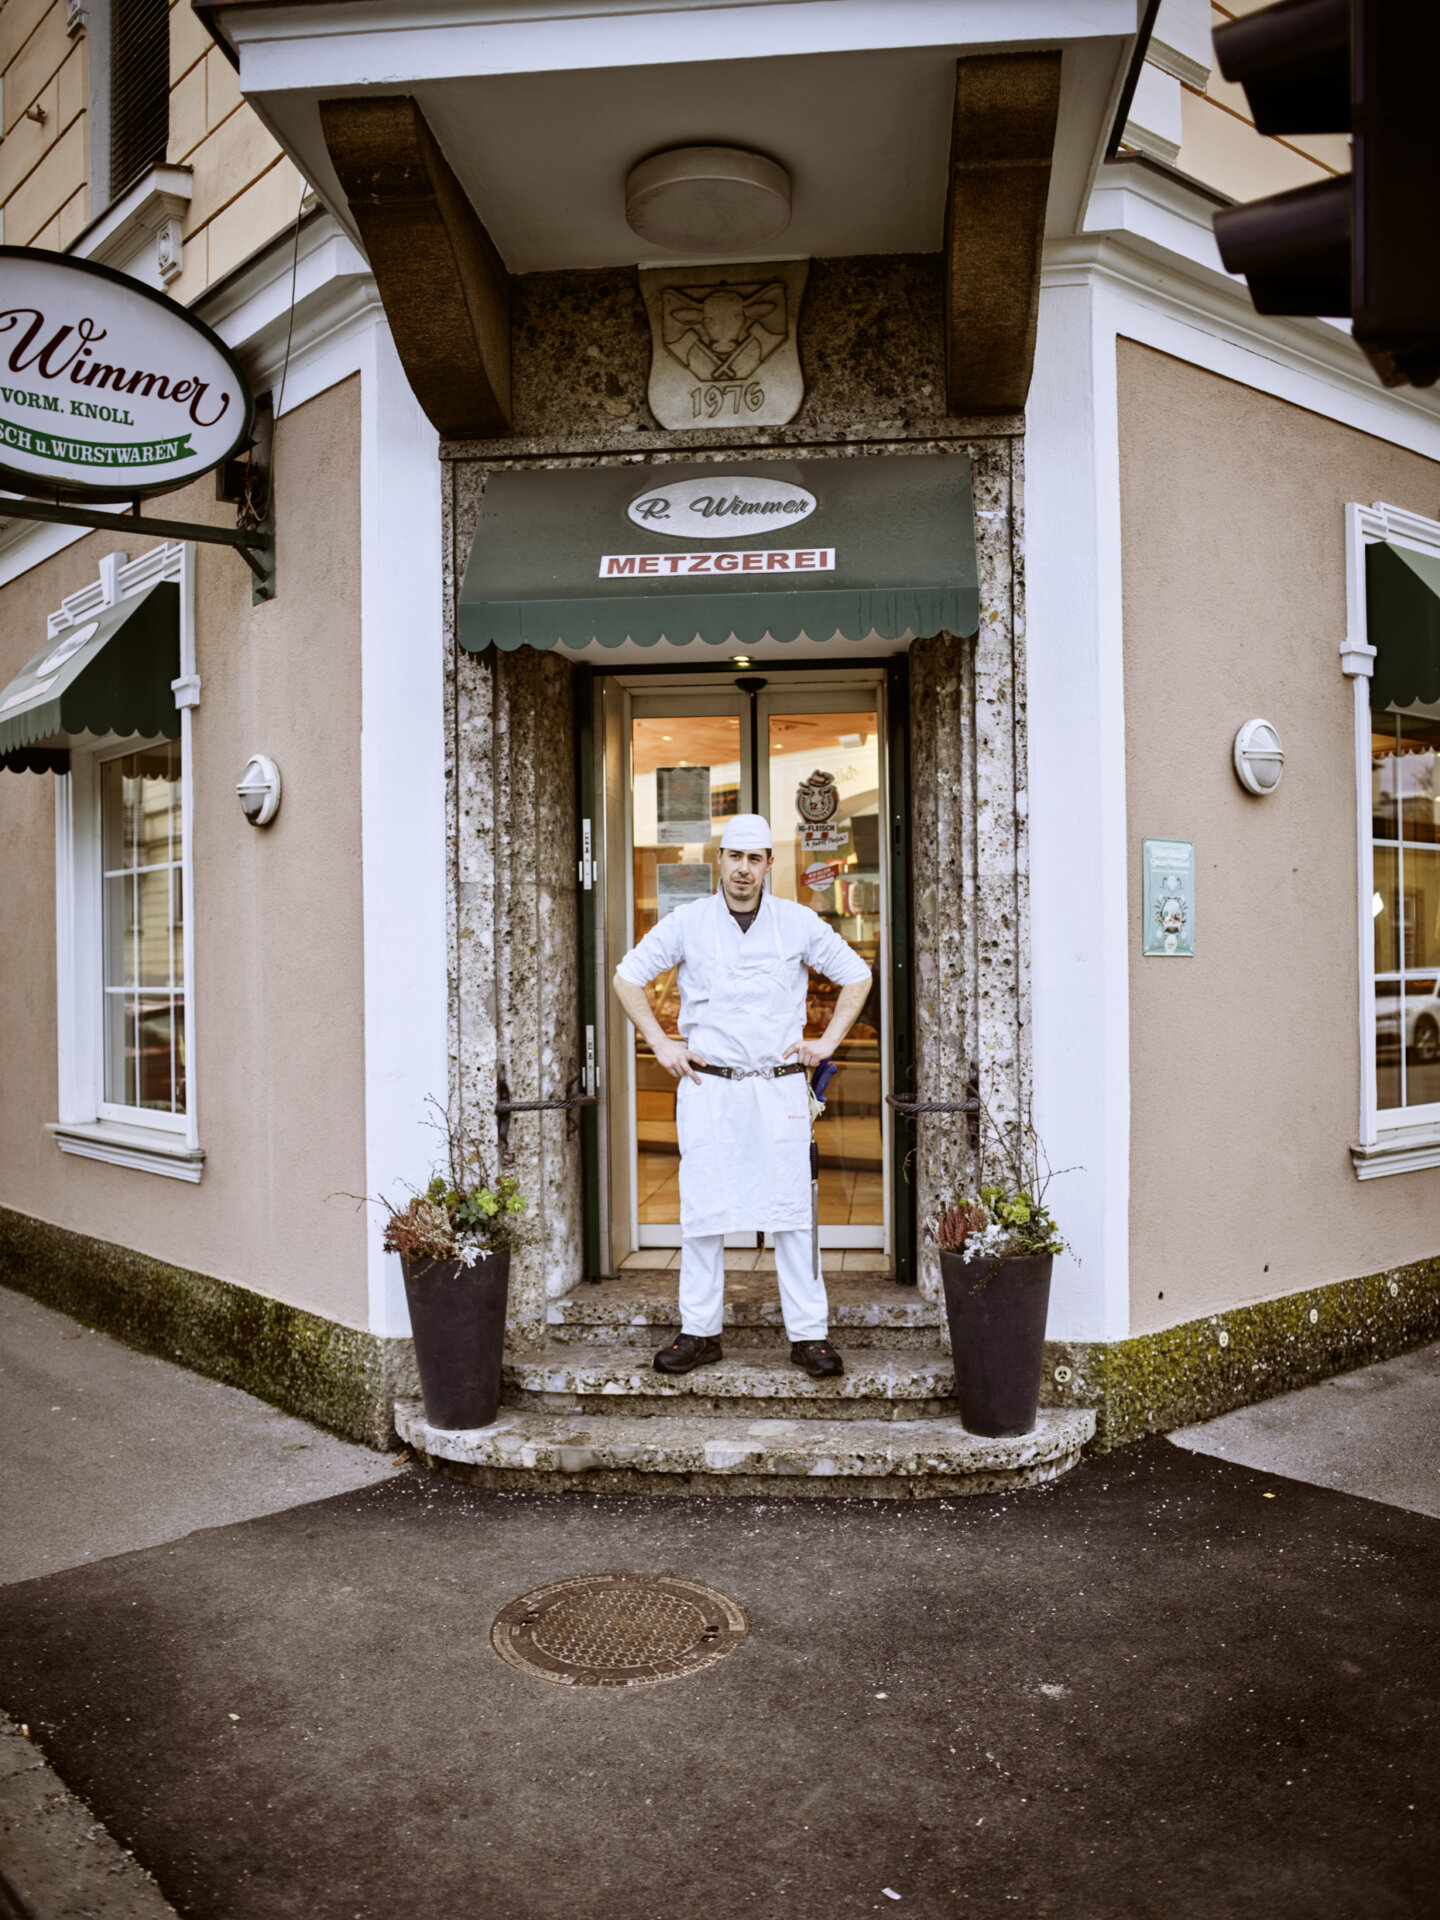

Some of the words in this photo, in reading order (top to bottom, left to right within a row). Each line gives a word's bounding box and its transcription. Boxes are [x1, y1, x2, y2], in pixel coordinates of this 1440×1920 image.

[0, 308, 230, 427] Wimmer
[0, 386, 65, 413] VORM.
[69, 400, 135, 426] KNOLL
[690, 381, 765, 419] 1976
[635, 497, 671, 520] R.
[689, 495, 809, 518] Wimmer
[606, 550, 828, 575] METZGEREI
